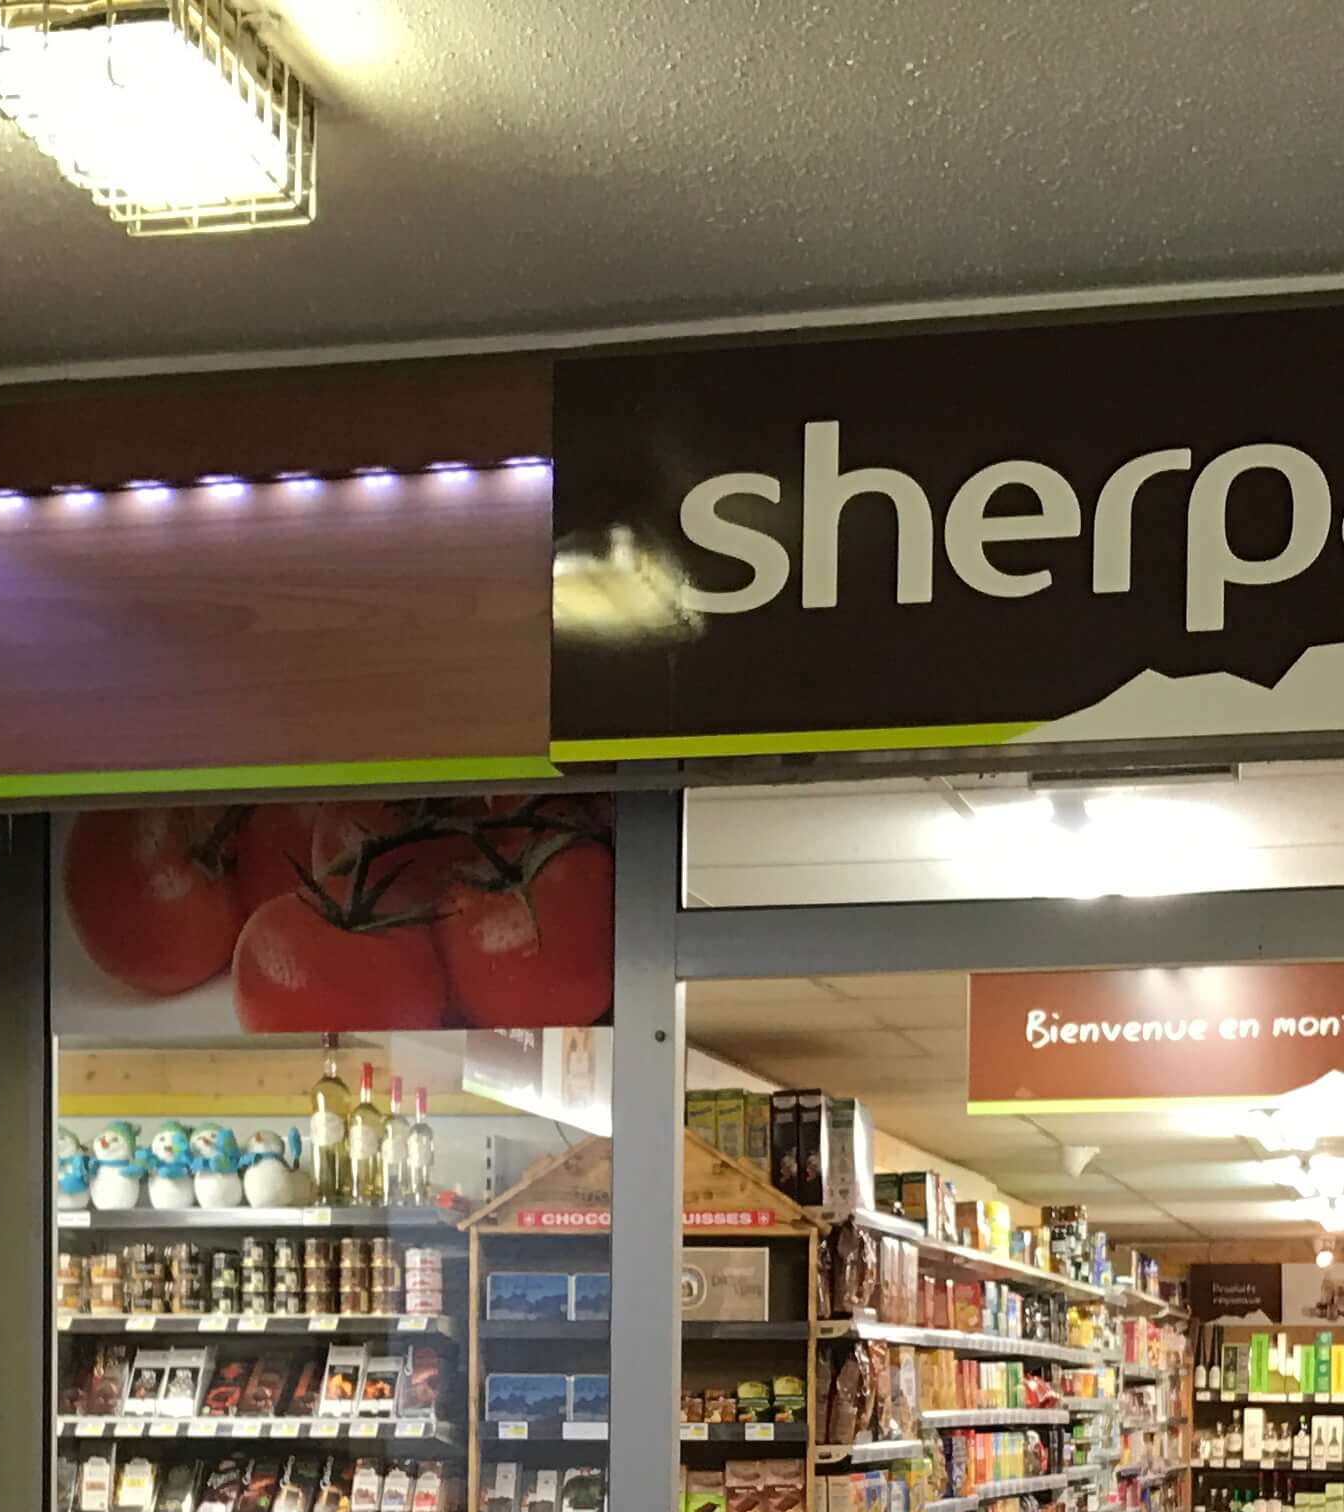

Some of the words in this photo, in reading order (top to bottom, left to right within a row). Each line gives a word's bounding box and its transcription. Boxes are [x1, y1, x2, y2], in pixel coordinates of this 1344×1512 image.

[1025, 1008, 1207, 1049] Bienvenue
[1218, 1016, 1260, 1041] en
[541, 1212, 611, 1226] CHOCO
[682, 1211, 752, 1225] UISSES
